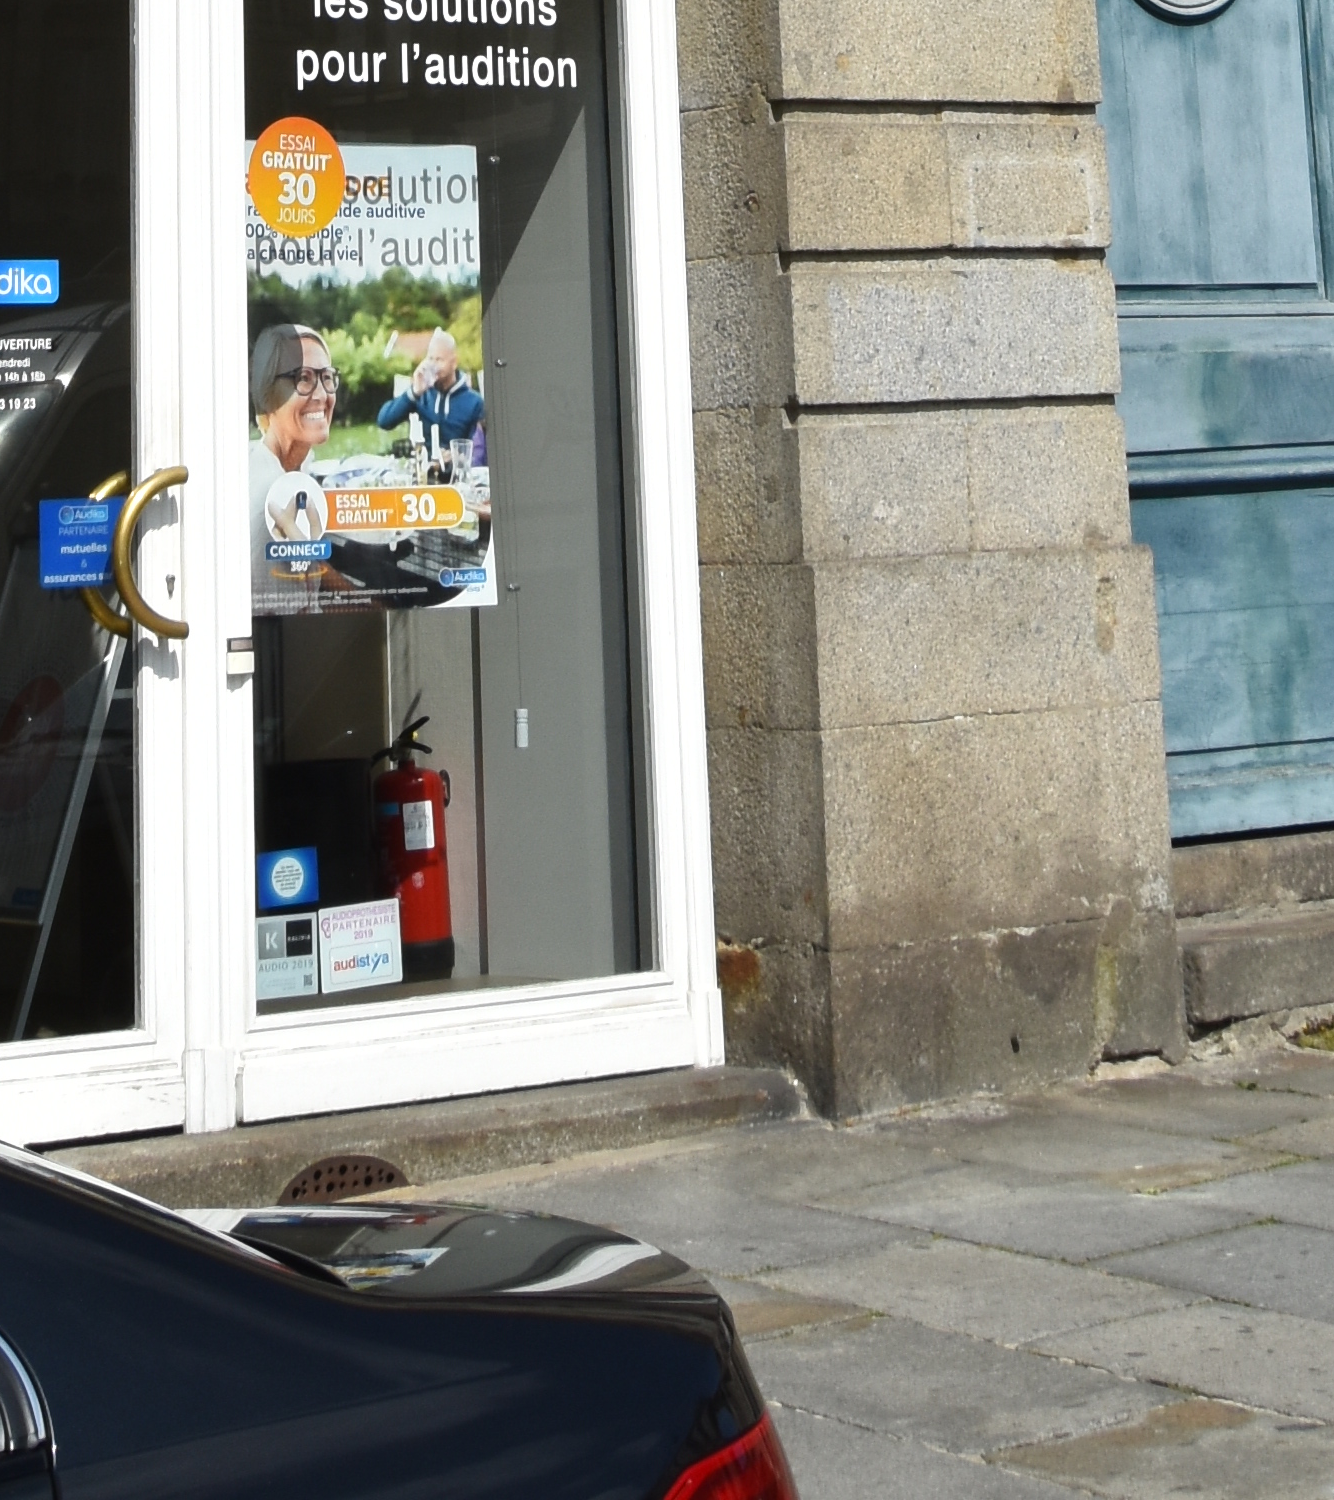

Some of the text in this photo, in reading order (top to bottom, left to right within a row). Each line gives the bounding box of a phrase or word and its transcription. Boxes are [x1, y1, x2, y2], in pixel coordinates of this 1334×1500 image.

[297, 43, 577, 91] pour l'audition
[279, 134, 315, 152] ESSAI
[278, 172, 316, 206] 30
[276, 208, 316, 225] JOURS
[366, 203, 426, 219] auditive
[260, 245, 315, 264] change
[320, 245, 332, 261] la
[4, 371, 19, 382] 14h
[22, 370, 28, 382] à
[23, 398, 36, 410] 23
[75, 509, 105, 519] Audika
[335, 493, 457, 522] ESSAI 30 JOURS
[58, 525, 108, 536] PARTENAIRE
[61, 543, 107, 554] mutuelles
[269, 543, 327, 557] CONNECT
[44, 572, 97, 583] assurances
[454, 570, 485, 582] Audika
[332, 915, 396, 932] PARTENAIRE
[265, 931, 278, 950] K
[354, 929, 374, 940] 2019
[258, 959, 314, 973] AUDIO 2019
